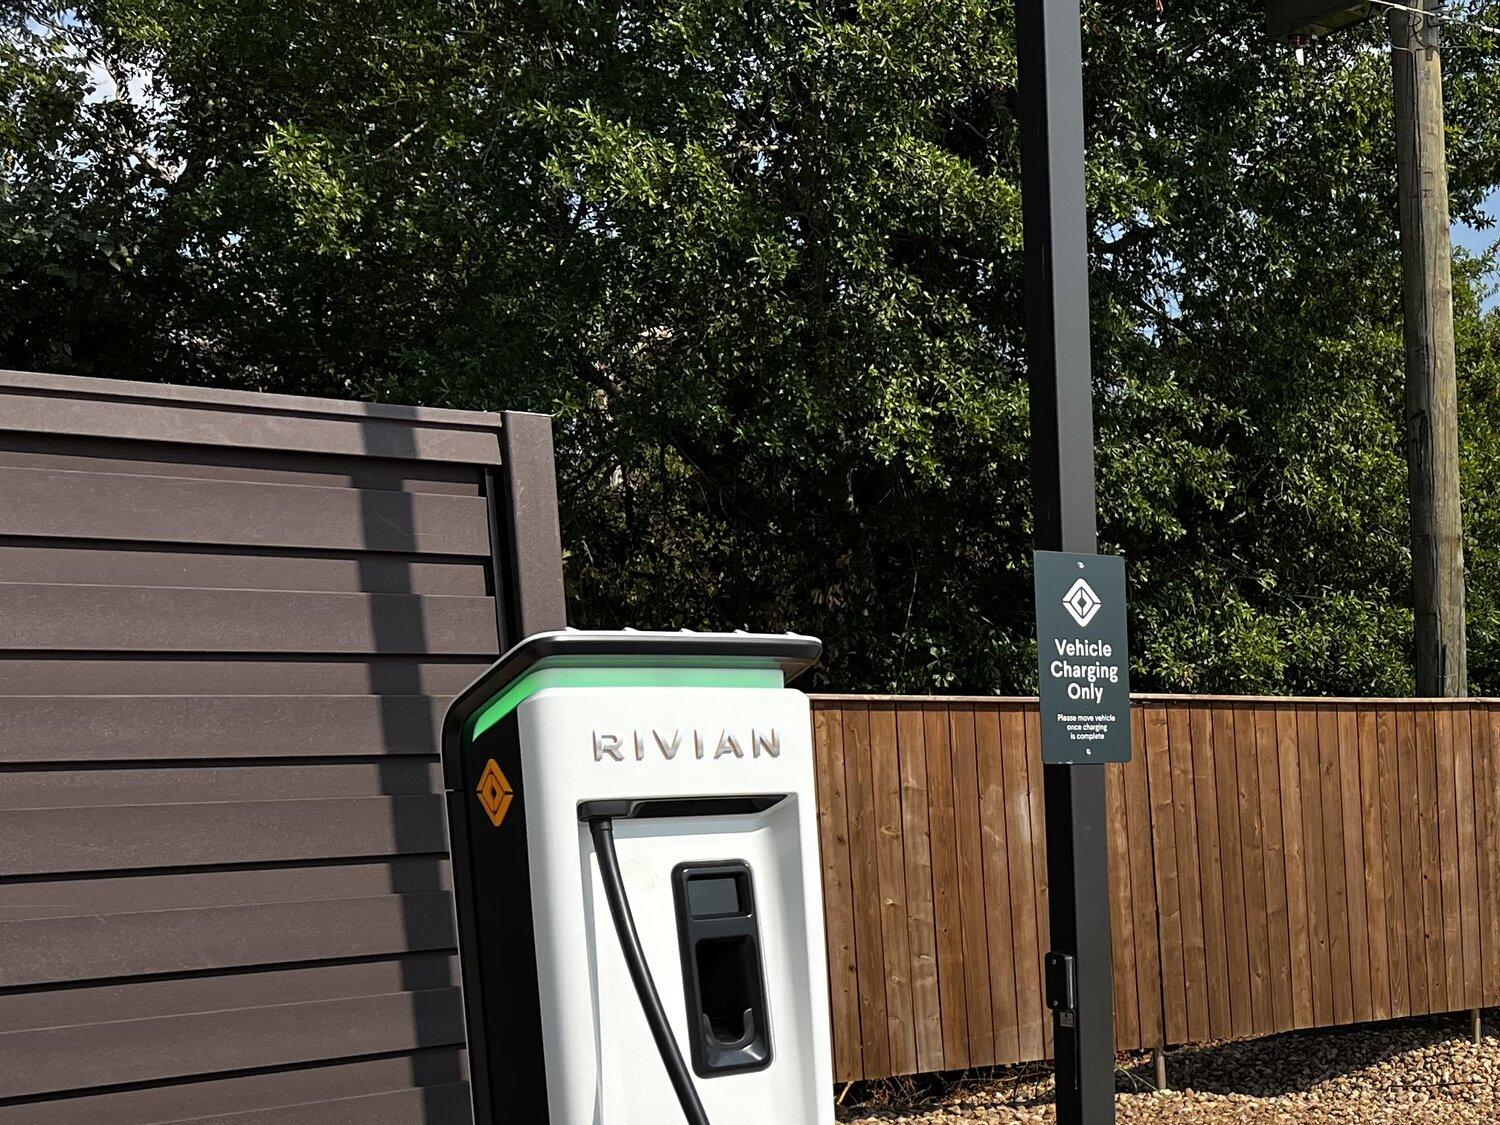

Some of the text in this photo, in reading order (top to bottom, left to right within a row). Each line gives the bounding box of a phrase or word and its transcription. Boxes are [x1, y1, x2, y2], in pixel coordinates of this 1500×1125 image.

[1054, 638, 1112, 657] Vehicle
[1050, 660, 1119, 683] Charging
[1067, 683, 1104, 704] Only
[592, 727, 781, 762] RIVIAN
